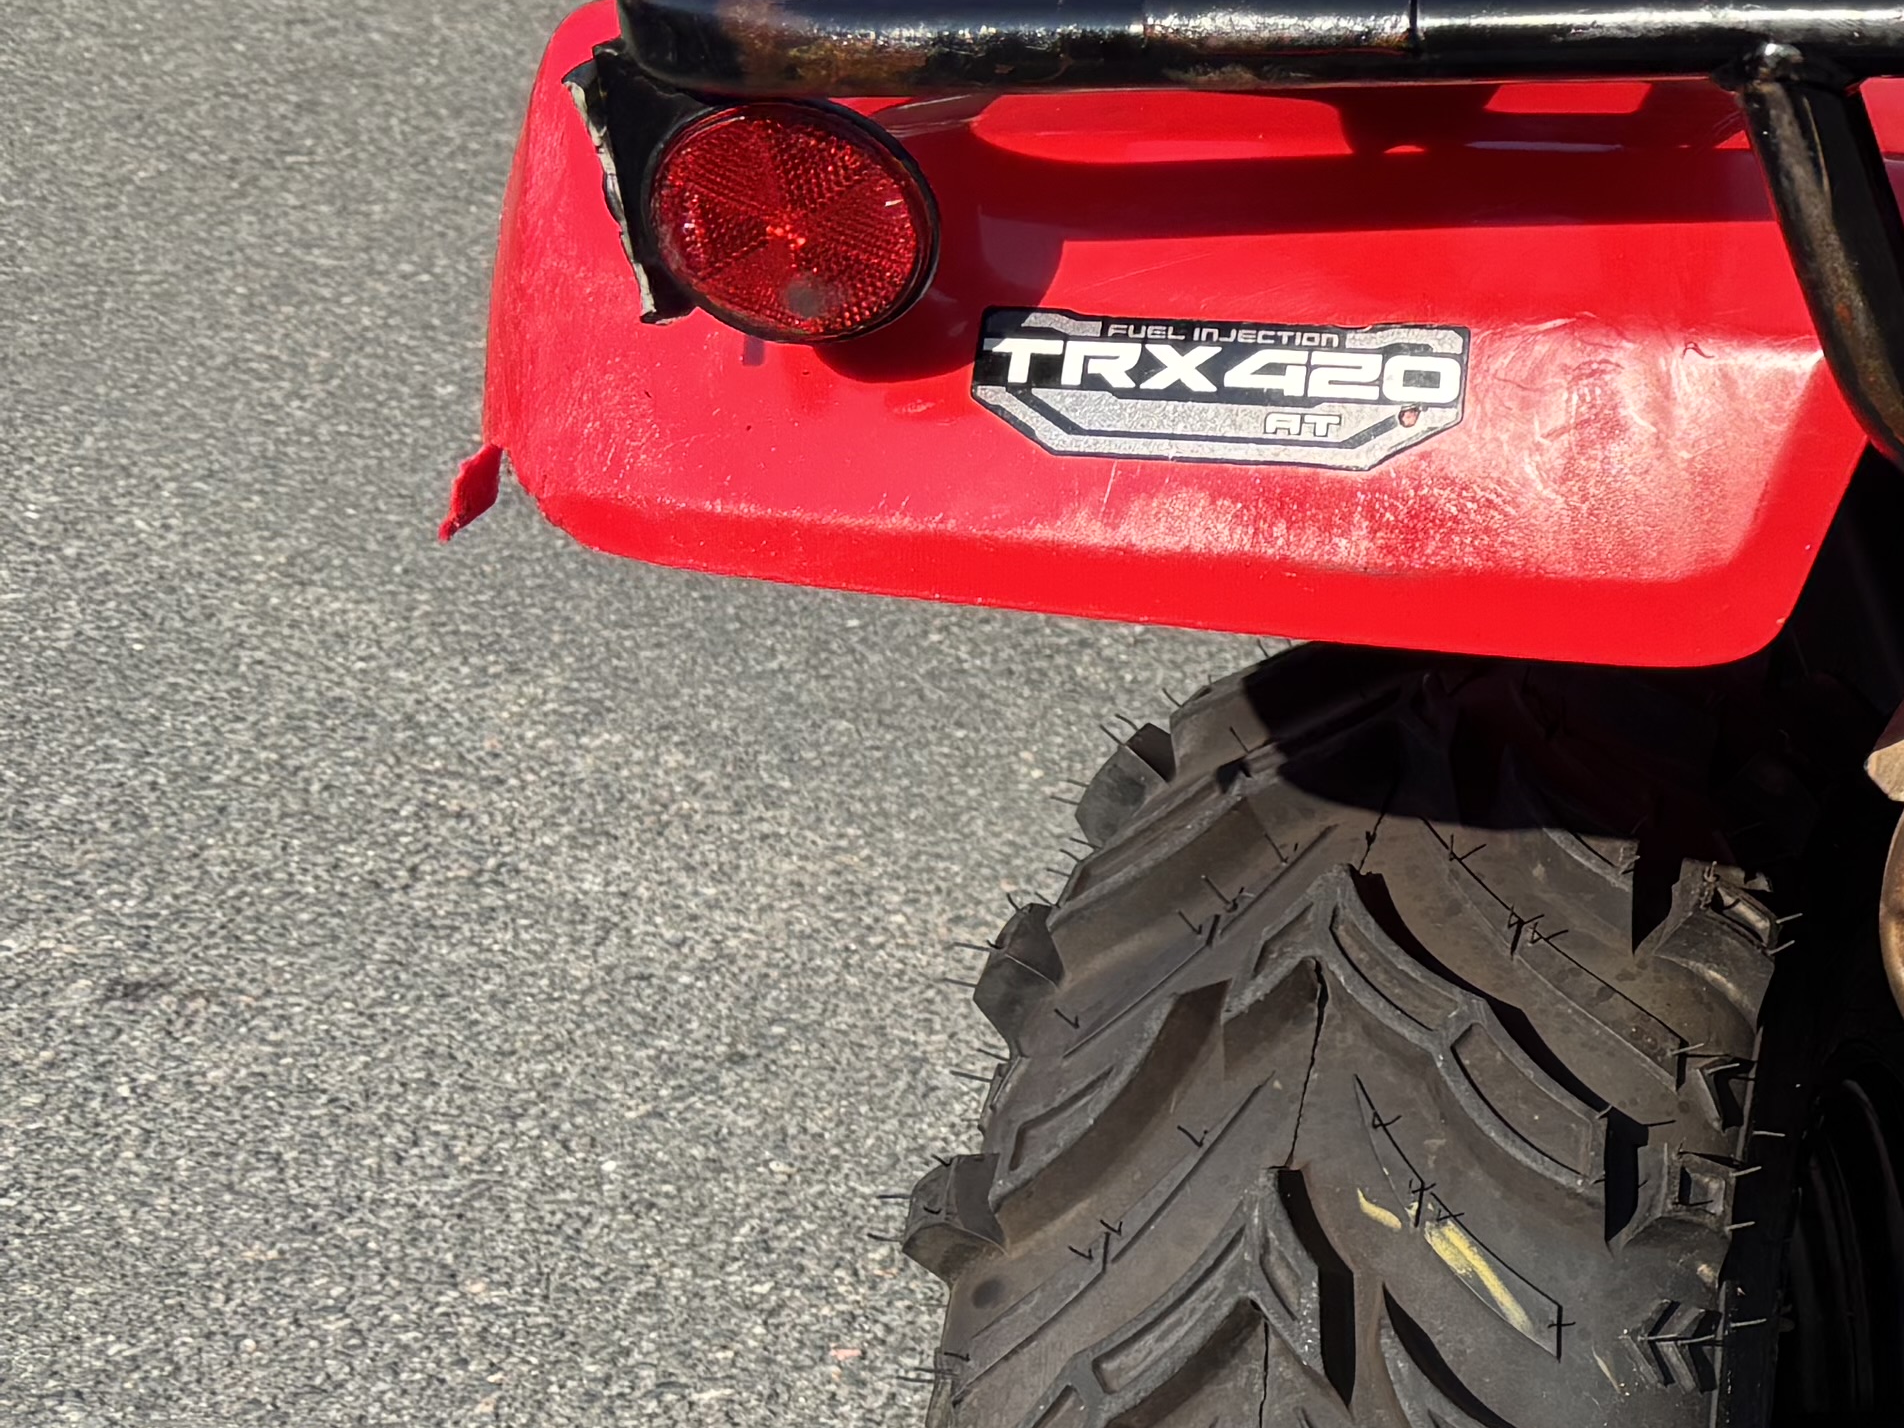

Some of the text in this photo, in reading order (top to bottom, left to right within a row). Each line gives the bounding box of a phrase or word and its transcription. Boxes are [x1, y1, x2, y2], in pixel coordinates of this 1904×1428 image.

[1107, 324, 1340, 348] FUEL INJECTION
[1264, 412, 1342, 438] AT
